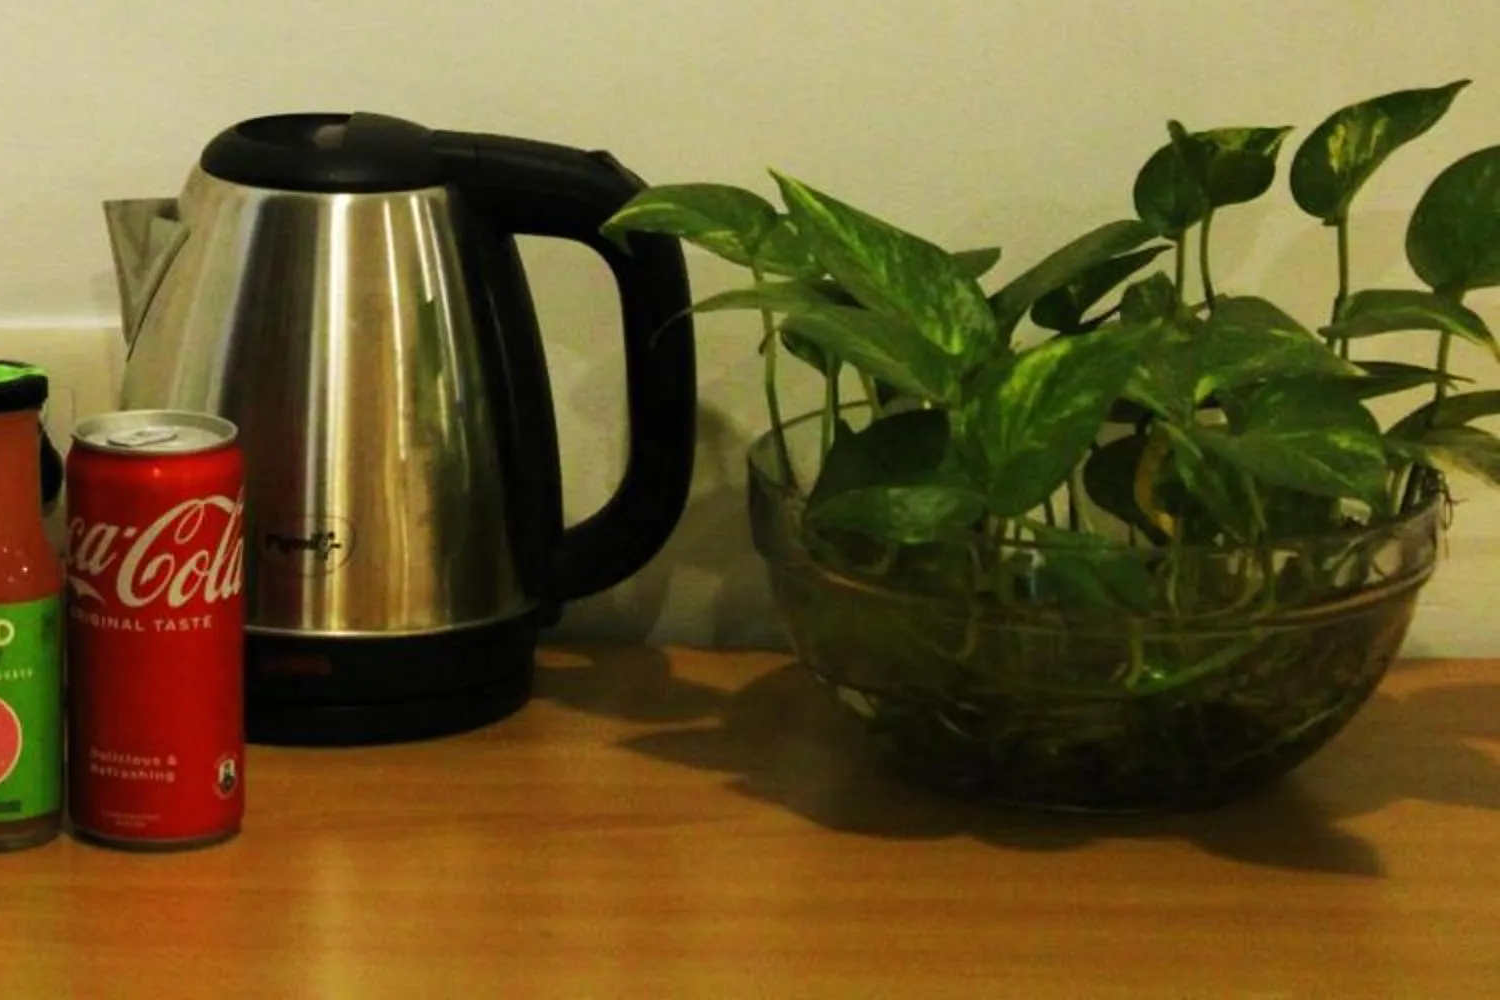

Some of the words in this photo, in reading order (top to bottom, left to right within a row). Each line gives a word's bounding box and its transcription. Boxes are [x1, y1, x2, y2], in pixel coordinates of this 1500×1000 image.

[153, 615, 213, 633] TASTE
[90, 746, 161, 767] Delicious
[166, 753, 179, 767] &
[89, 762, 177, 785] Refreshing
